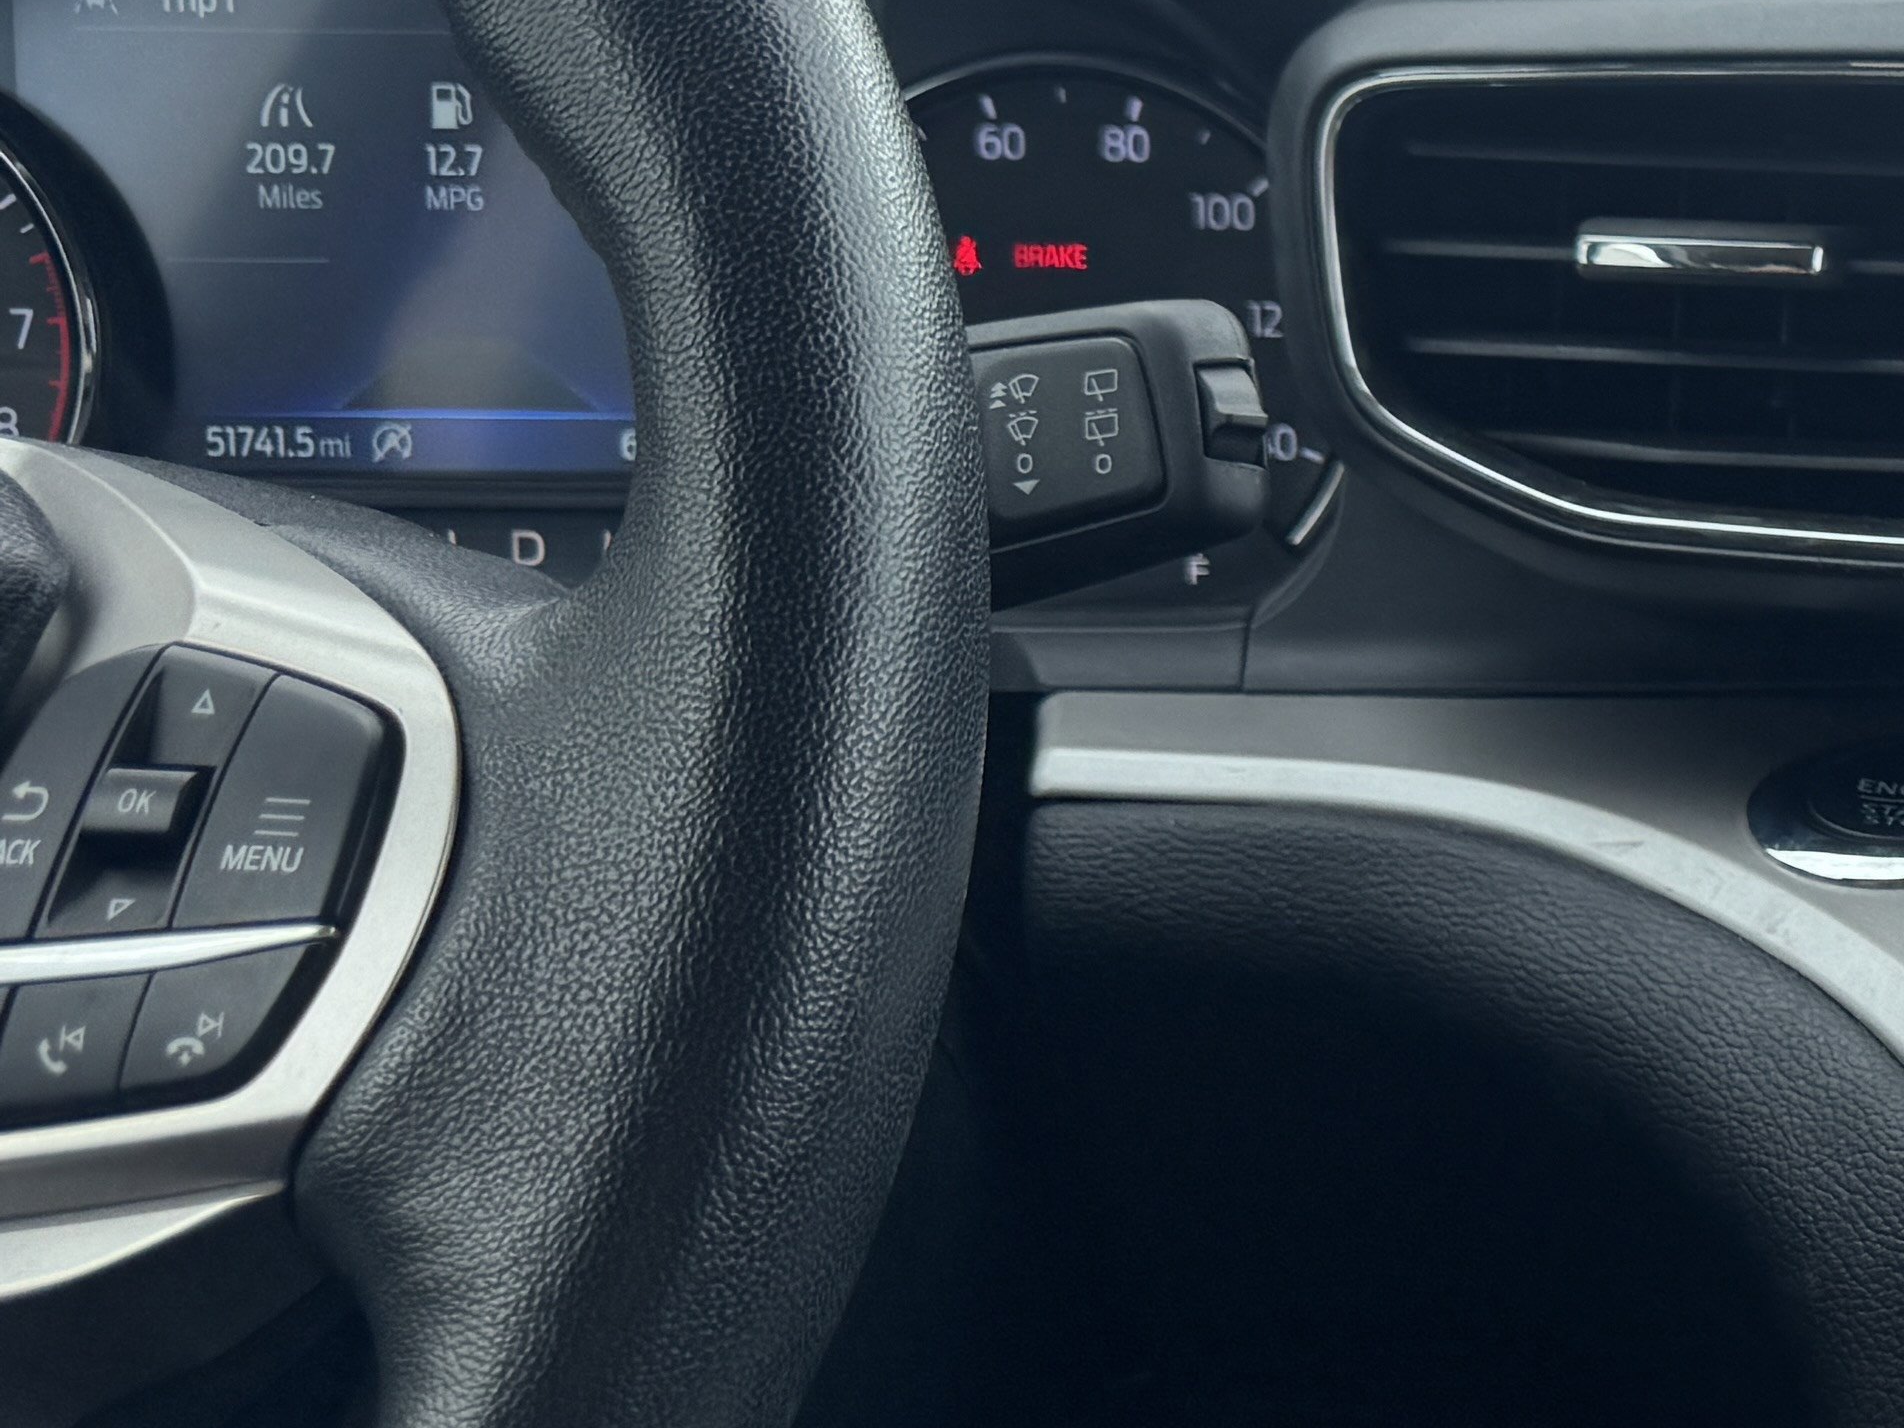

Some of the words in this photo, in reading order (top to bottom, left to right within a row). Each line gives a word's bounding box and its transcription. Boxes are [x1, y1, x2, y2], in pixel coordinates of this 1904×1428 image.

[245, 141, 336, 174] 209.7
[975, 123, 1026, 161] 60
[1102, 125, 1151, 163] 80
[425, 143, 484, 177] 12.7
[257, 183, 323, 209] Miles
[426, 185, 485, 212] MPG
[1190, 193, 1255, 231] 100
[1014, 243, 1088, 271] BRAKE
[9, 307, 34, 350] 7
[511, 529, 546, 566] D
[116, 787, 154, 815] OK
[219, 844, 304, 874] MENU
